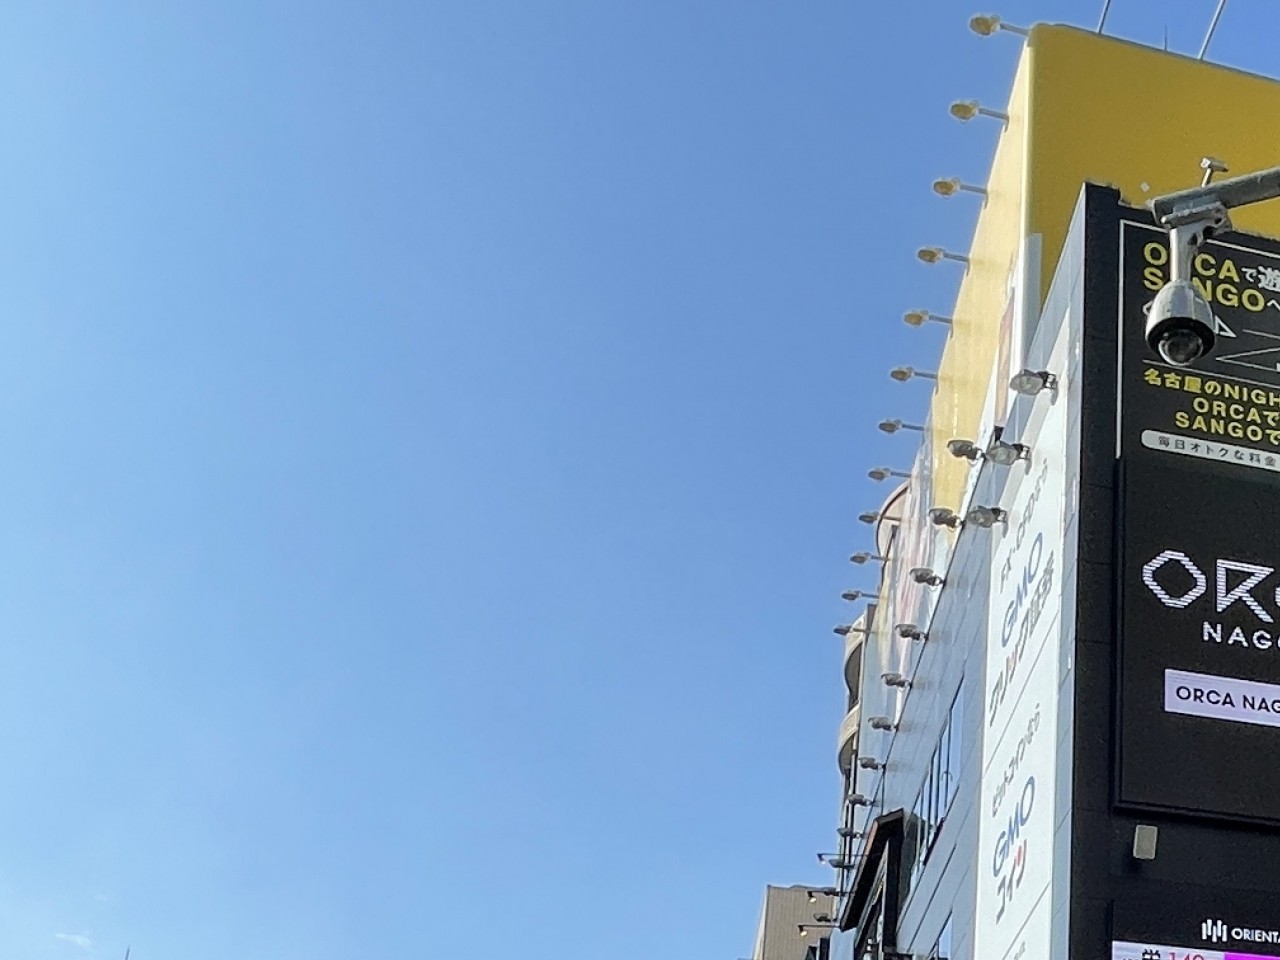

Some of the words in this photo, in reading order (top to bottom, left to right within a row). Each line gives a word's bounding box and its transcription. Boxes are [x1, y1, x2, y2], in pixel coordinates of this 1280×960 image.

[1002, 532, 1043, 648] GMO
[1175, 685, 1236, 708] ORCA
[993, 775, 1036, 879] GMO
